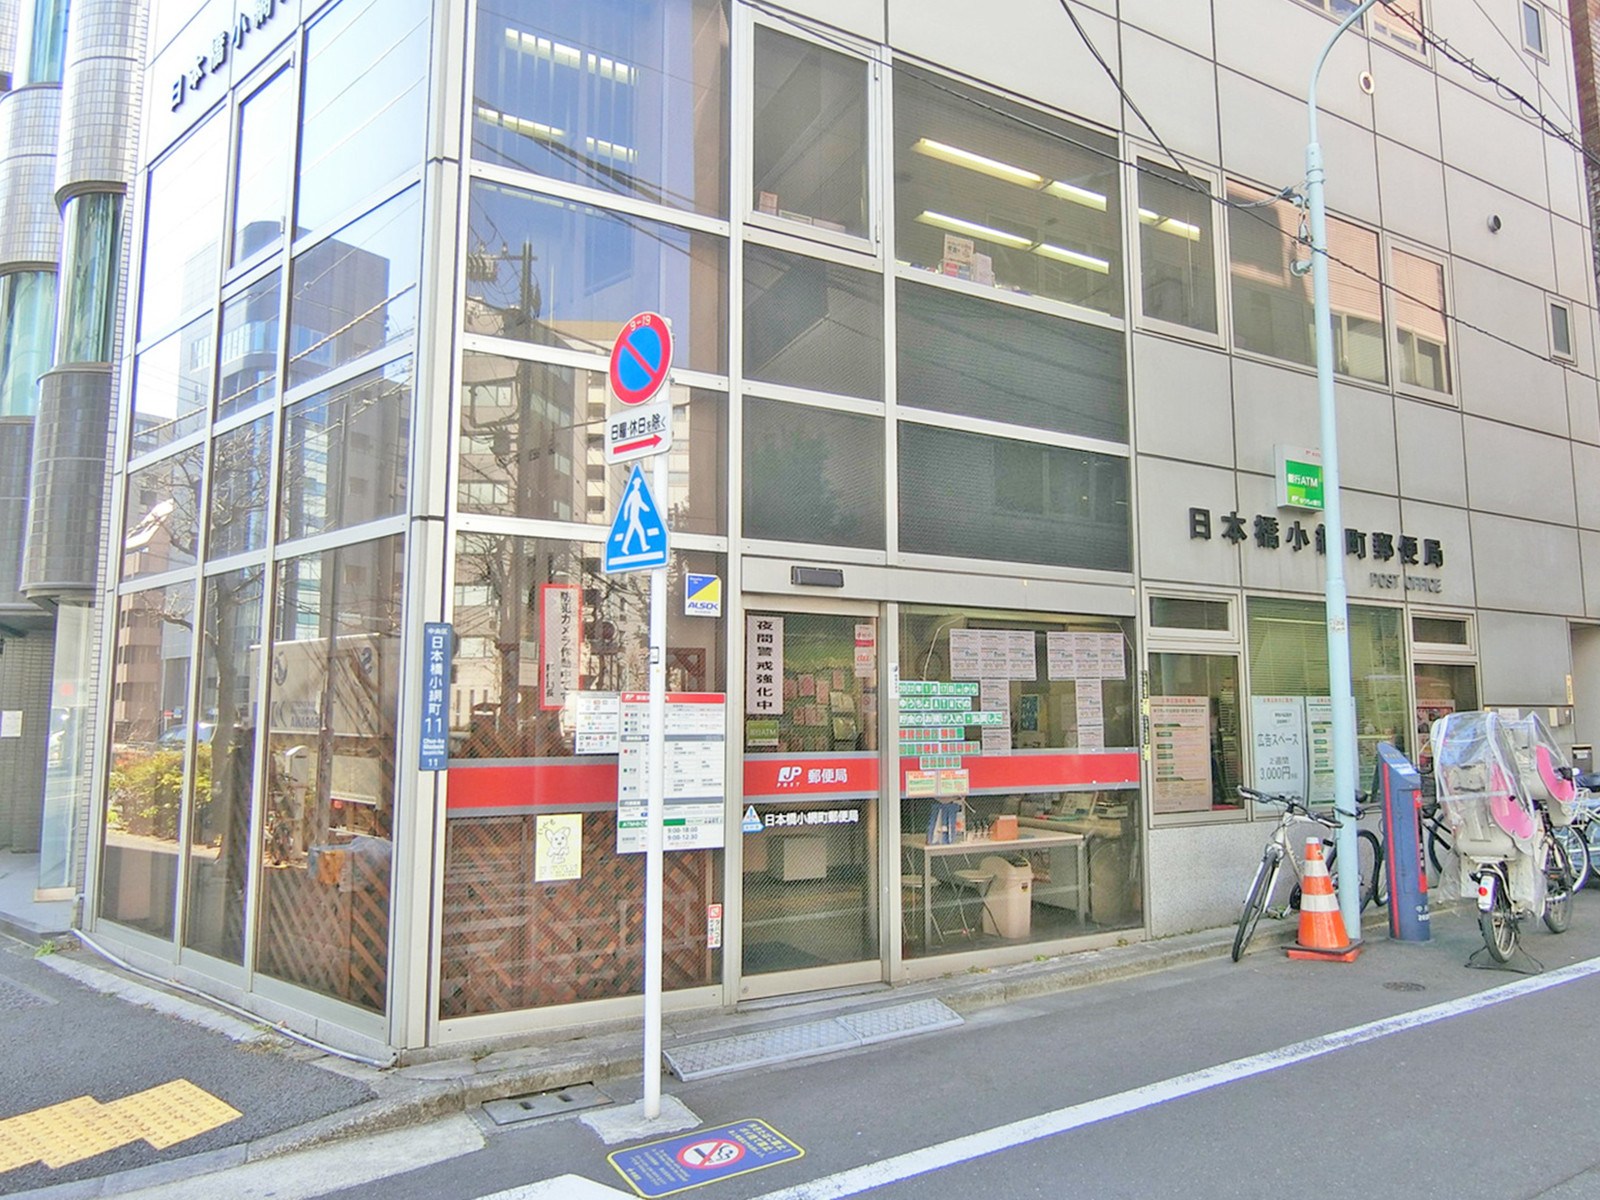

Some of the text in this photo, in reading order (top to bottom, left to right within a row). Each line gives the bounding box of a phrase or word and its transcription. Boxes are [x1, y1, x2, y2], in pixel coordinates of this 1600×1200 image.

[630, 315, 652, 332] 9-19
[1369, 572, 1442, 593] POST OFFICE
[688, 602, 719, 610] ALSOK
[756, 620, 774, 711] 夜間警戒強化中
[428, 636, 444, 717] 日本橋小網町
[424, 717, 443, 734] 11
[1258, 733, 1299, 747] 広告スペース
[428, 757, 439, 767] 11
[807, 768, 848, 784] 郵便局
[764, 809, 859, 827] 日本橋小網町郵便局
